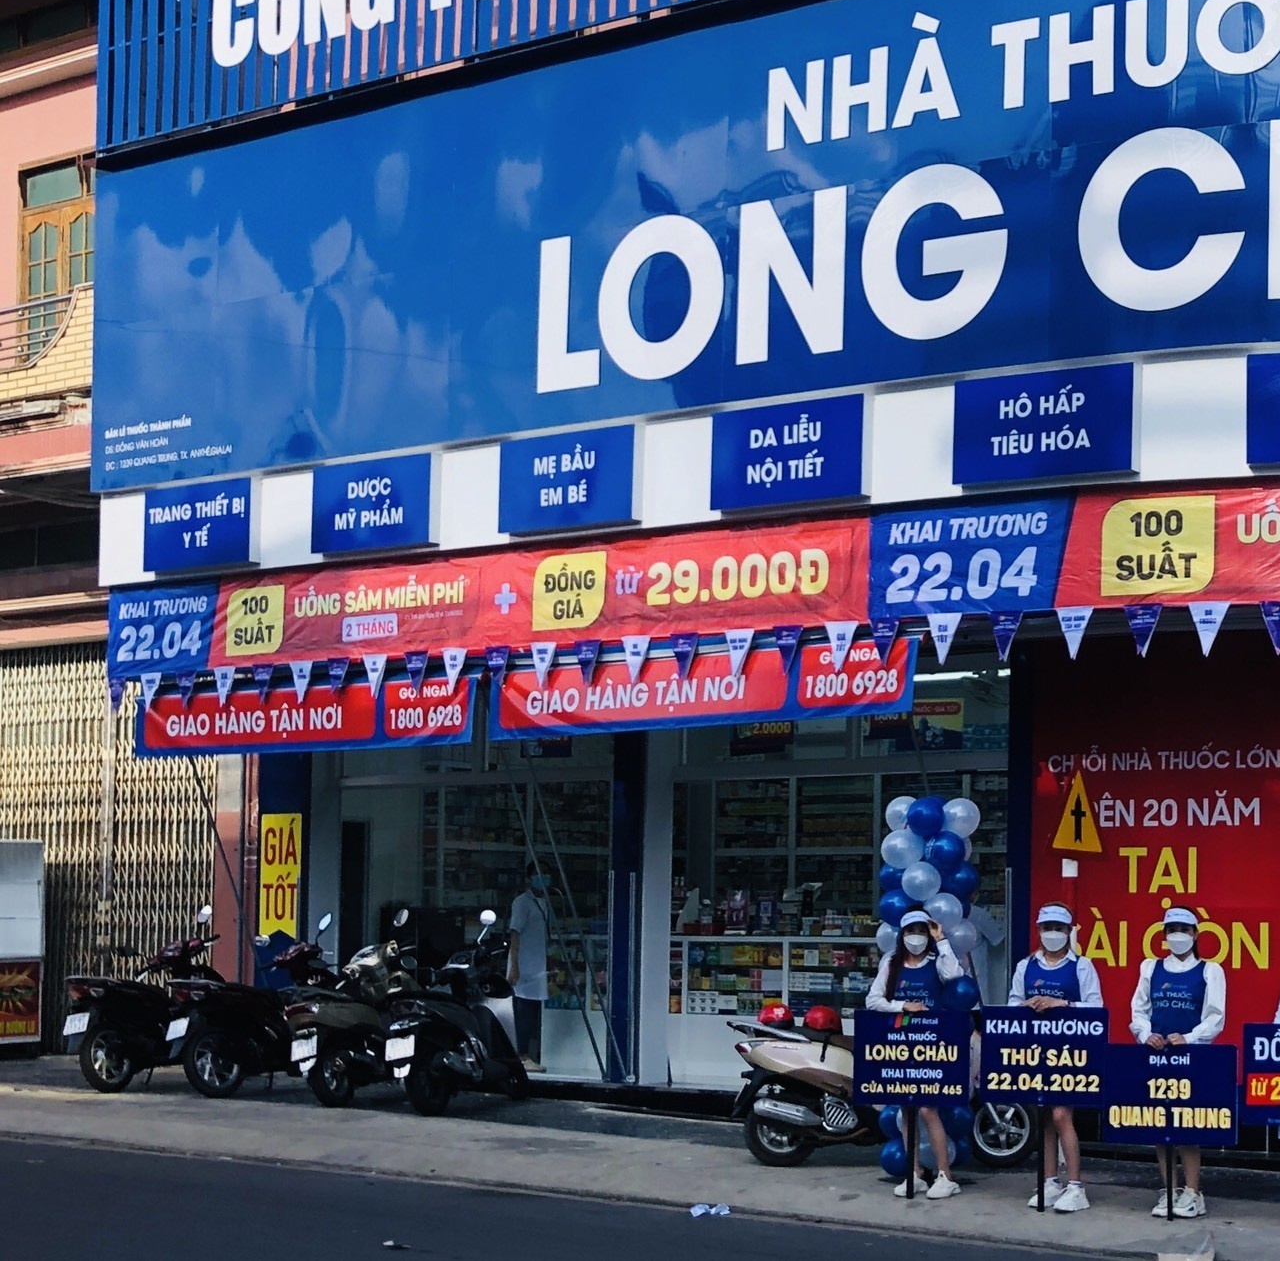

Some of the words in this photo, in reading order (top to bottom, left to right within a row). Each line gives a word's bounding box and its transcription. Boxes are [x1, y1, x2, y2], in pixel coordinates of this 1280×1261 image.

[767, 11, 962, 153] NHÀ
[536, 163, 1009, 395] LONG
[999, 392, 1033, 421] HÔ
[1040, 383, 1086, 415] HẤP
[749, 427, 779, 450] DA
[783, 412, 822, 447] LIỄU
[991, 430, 1034, 457] TIÊU
[1040, 423, 1091, 451] HÓA
[533, 455, 557, 480] MẸ
[561, 442, 596, 471] BẦU
[746, 462, 782, 489] NỘI
[788, 448, 825, 480] TIẾT
[347, 476, 392, 501] DƯỢC
[540, 488, 563, 508] EM
[568, 479, 588, 504] BÉ
[149, 503, 192, 525] TRANG
[195, 492, 229, 519] THIẾT
[232, 496, 245, 518] BỊ
[334, 506, 360, 532] MỸ
[363, 496, 404, 528] PHẨM
[1129, 509, 1184, 539] 100
[183, 532, 191, 548] Y
[195, 522, 211, 548] TẾ
[888, 519, 942, 546] KHAI
[948, 510, 1049, 541] TRƯƠNG
[885, 545, 1038, 605] 22.04
[1115, 541, 1199, 581] SUẤT
[543, 562, 596, 597] ĐỒNG
[615, 567, 644, 596] từ
[646, 547, 830, 607] 29.000Đ
[119, 600, 151, 620] KHAI
[153, 595, 208, 617] TRƯƠNG
[242, 595, 269, 616] 100
[294, 585, 341, 618] UỐNG
[343, 586, 382, 615] SÂM
[385, 573, 431, 610] MIỄN
[432, 574, 466, 606] PHÍ
[552, 591, 585, 620] GIÁ
[116, 620, 202, 663] 22.04
[233, 616, 275, 646] SUẤT
[345, 625, 353, 638] 2
[356, 615, 395, 637] THÁNG
[526, 687, 580, 717] GIAO
[585, 675, 649, 711] HÀNG
[654, 673, 698, 717] TẬN
[702, 673, 746, 702] NƠI
[805, 671, 848, 699] 1800
[851, 668, 899, 696] 6928
[166, 712, 211, 738] GIAO
[214, 705, 265, 736] HÀNG
[269, 702, 304, 738] TẬN
[309, 705, 343, 732] NƠI
[390, 707, 424, 731] 1800
[427, 704, 462, 728] 6928
[1112, 747, 1153, 771] NHÀ
[1157, 742, 1230, 770] THUỐC
[1236, 743, 1280, 769] LỚN
[1094, 792, 1135, 828] ÊN
[1143, 798, 1178, 827] 20
[1187, 789, 1261, 827] NĂM
[264, 818, 298, 866] GIÁ
[1119, 846, 1198, 909] TẠI
[262, 869, 298, 921] TỐT
[888, 1031, 906, 1041] NHÀ
[908, 1030, 937, 1041] THUỐC
[985, 1019, 1027, 1034] KHAI
[1032, 1018, 1104, 1036] TRƯƠNG
[865, 1044, 909, 1062] LONG
[913, 1041, 958, 1062] CHÂU
[1000, 1044, 1041, 1066] THỨ
[1046, 1044, 1088, 1066] SÁU
[1149, 1055, 1168, 1068] ĐỊA
[1170, 1052, 1190, 1066] CHỈ
[861, 1080, 885, 1094] CỬA
[887, 1081, 918, 1094] HÀNG
[919, 1081, 941, 1095] THỨ
[942, 1085, 963, 1095] 465
[881, 1068, 904, 1079] KHAI
[905, 1067, 943, 1080] TRƯƠNG
[987, 1072, 1100, 1092] 22.04.2022
[1147, 1077, 1191, 1100] 1239
[1251, 1077, 1269, 1097] từ
[1108, 1105, 1167, 1128] QUANG
[1171, 1106, 1232, 1129] TRUNG
